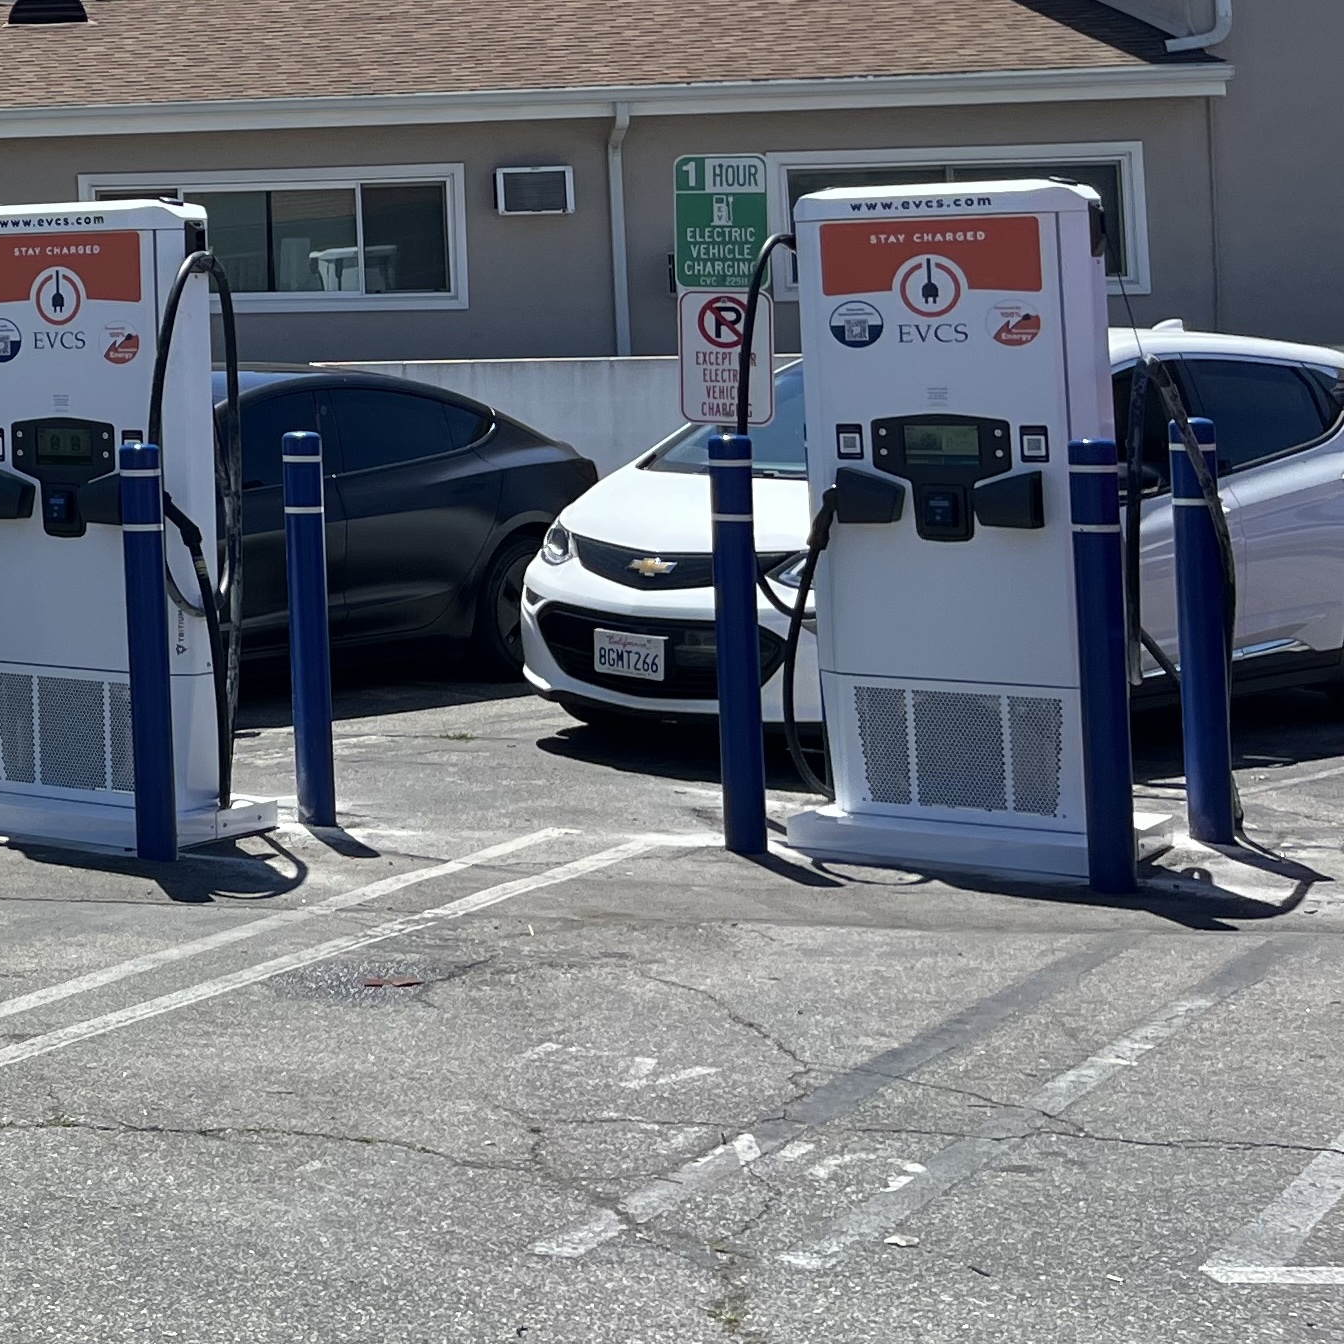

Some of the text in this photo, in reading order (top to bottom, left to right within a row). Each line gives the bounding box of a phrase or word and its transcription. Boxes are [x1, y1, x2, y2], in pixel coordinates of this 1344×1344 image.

[682, 161, 758, 188] 1 HOUR
[850, 196, 992, 212] www.evcs.com
[0, 214, 104, 228] www.evcs.com
[686, 228, 756, 242] ELECTRIC
[870, 231, 986, 244] STAY CHARGED
[14, 244, 100, 256] STAY CHARGED
[690, 244, 752, 258] VEHICLE
[700, 277, 718, 286] CVC
[33, 331, 86, 350] EVCS
[897, 323, 969, 344] EVCS
[1001, 332, 1032, 342] Energy
[696, 351, 732, 366] EXCEPT
[606, 636, 647, 648] California
[598, 646, 658, 673] 8GMT266
